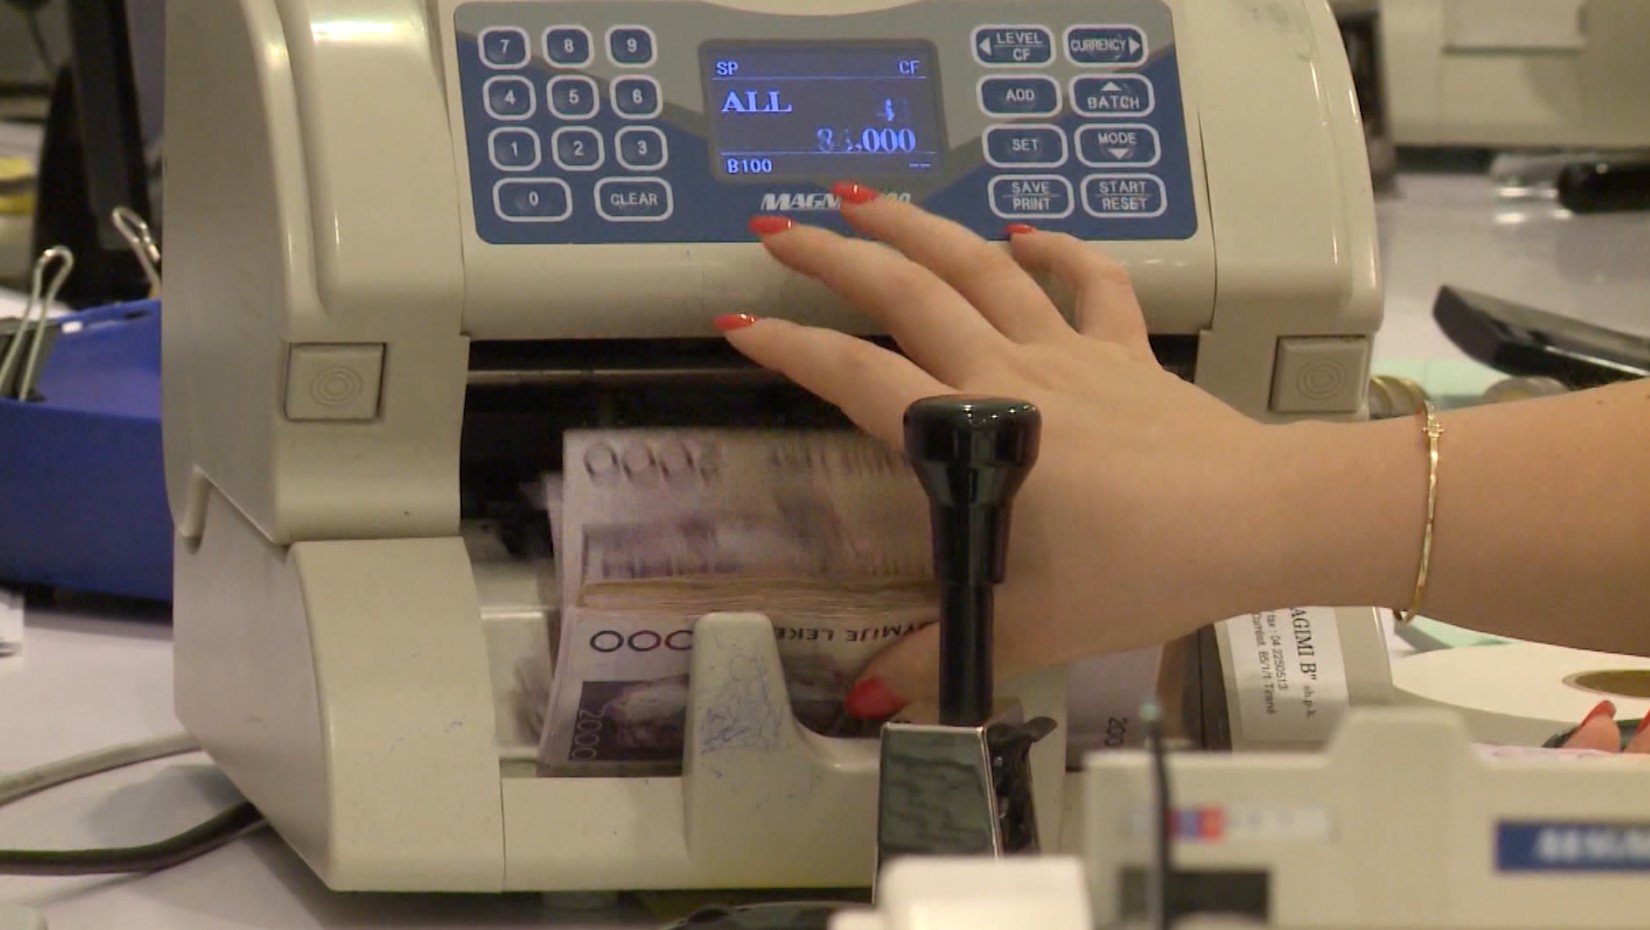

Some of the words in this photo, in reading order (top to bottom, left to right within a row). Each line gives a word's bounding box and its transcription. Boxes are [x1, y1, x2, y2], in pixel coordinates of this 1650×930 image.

[563, 38, 575, 53] 8
[626, 38, 638, 53] 9
[996, 32, 1043, 45] LEVEL
[1070, 38, 1127, 52] CURRENCY
[500, 39, 511, 54] 7
[1012, 48, 1031, 61] CF
[716, 61, 739, 76] SP
[898, 60, 921, 75] CF
[505, 89, 516, 104] 4
[568, 89, 580, 104] 5
[631, 89, 643, 104] 6
[721, 91, 793, 113] ALL
[1006, 88, 1035, 102] ADD
[1087, 97, 1140, 110] BATCH
[1012, 138, 1040, 151] SET
[1098, 132, 1137, 145] MODE
[510, 141, 519, 157] 1
[573, 140, 585, 156] 2
[636, 140, 648, 155] 3
[727, 159, 772, 173] B100
[1012, 181, 1049, 194] SAVE
[1099, 180, 1146, 194] START
[528, 191, 540, 206] 0
[610, 192, 659, 206] CLEAR
[760, 193, 842, 211] MAGN
[1013, 196, 1051, 210] PRINT
[1102, 195, 1147, 209] RESET
